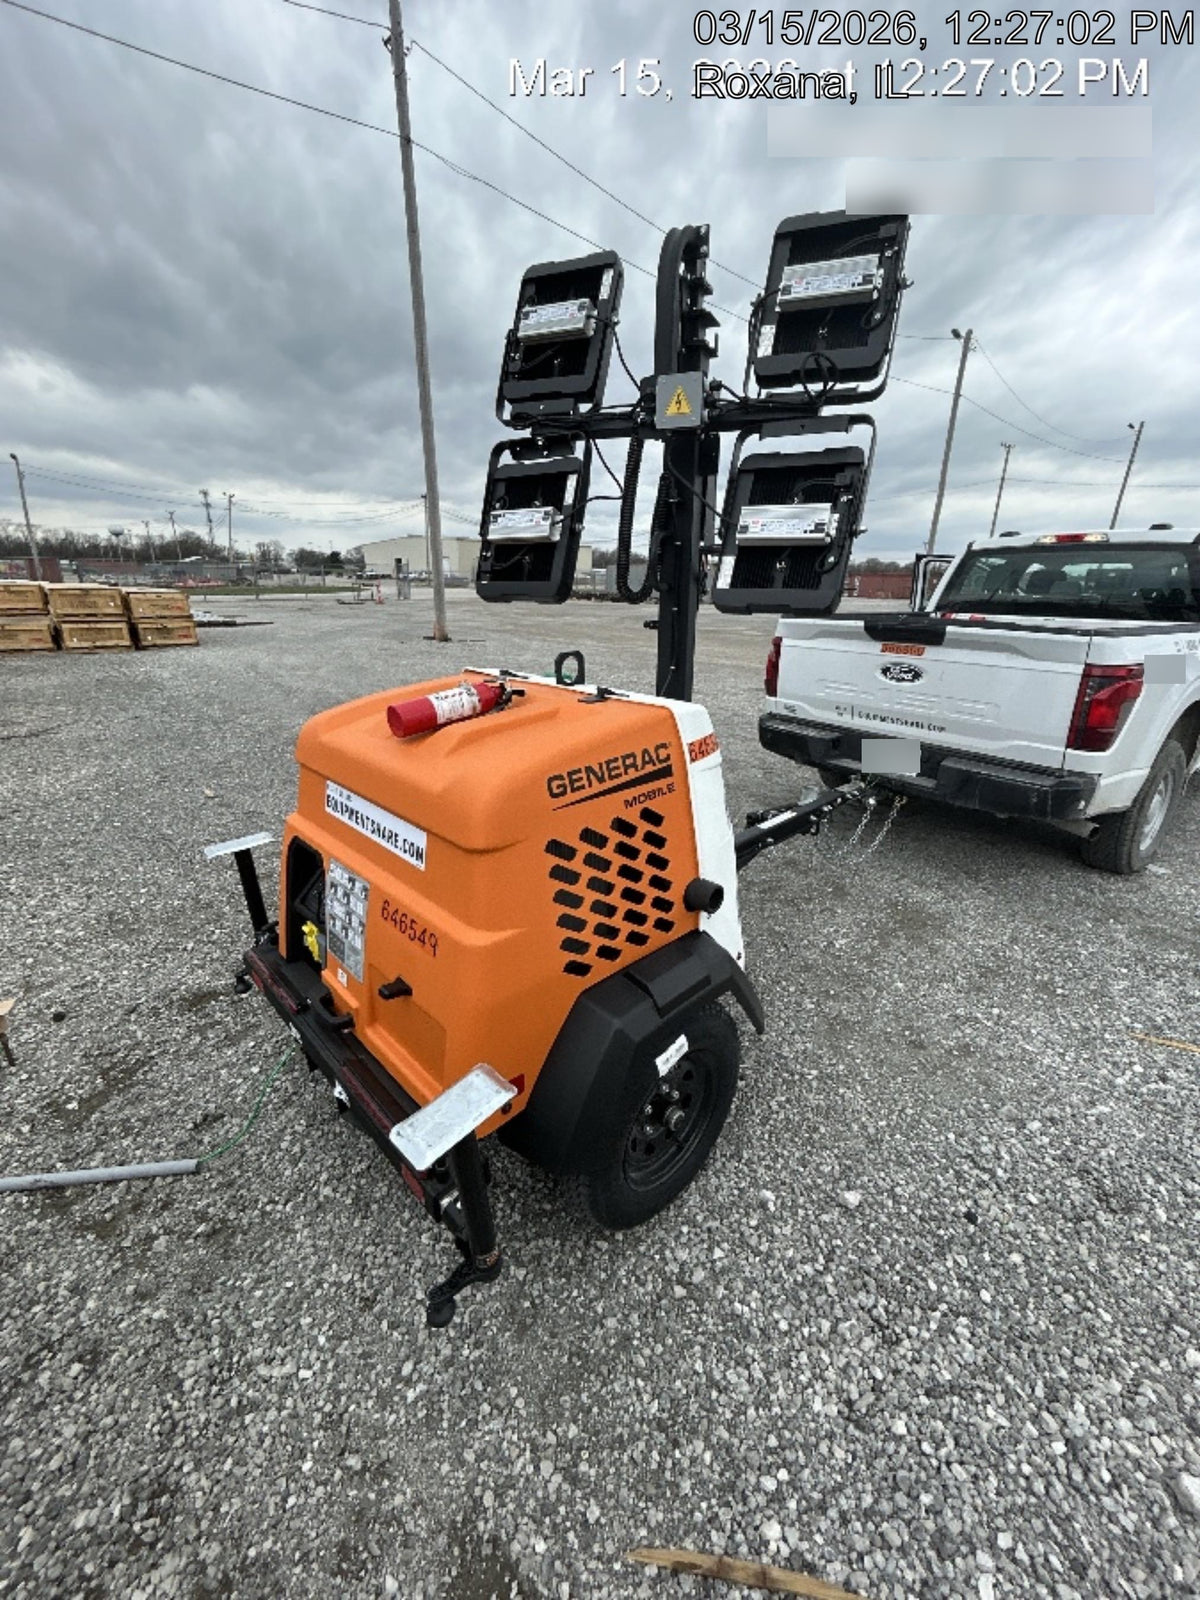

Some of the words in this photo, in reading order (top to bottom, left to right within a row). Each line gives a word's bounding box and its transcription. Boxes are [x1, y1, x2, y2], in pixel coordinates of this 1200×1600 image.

[546, 742, 671, 799] GENERAC
[624, 783, 676, 809] MOBILE
[326, 794, 425, 865] EQUIPMENTSHARE.COM
[381, 899, 438, 958] 646549
